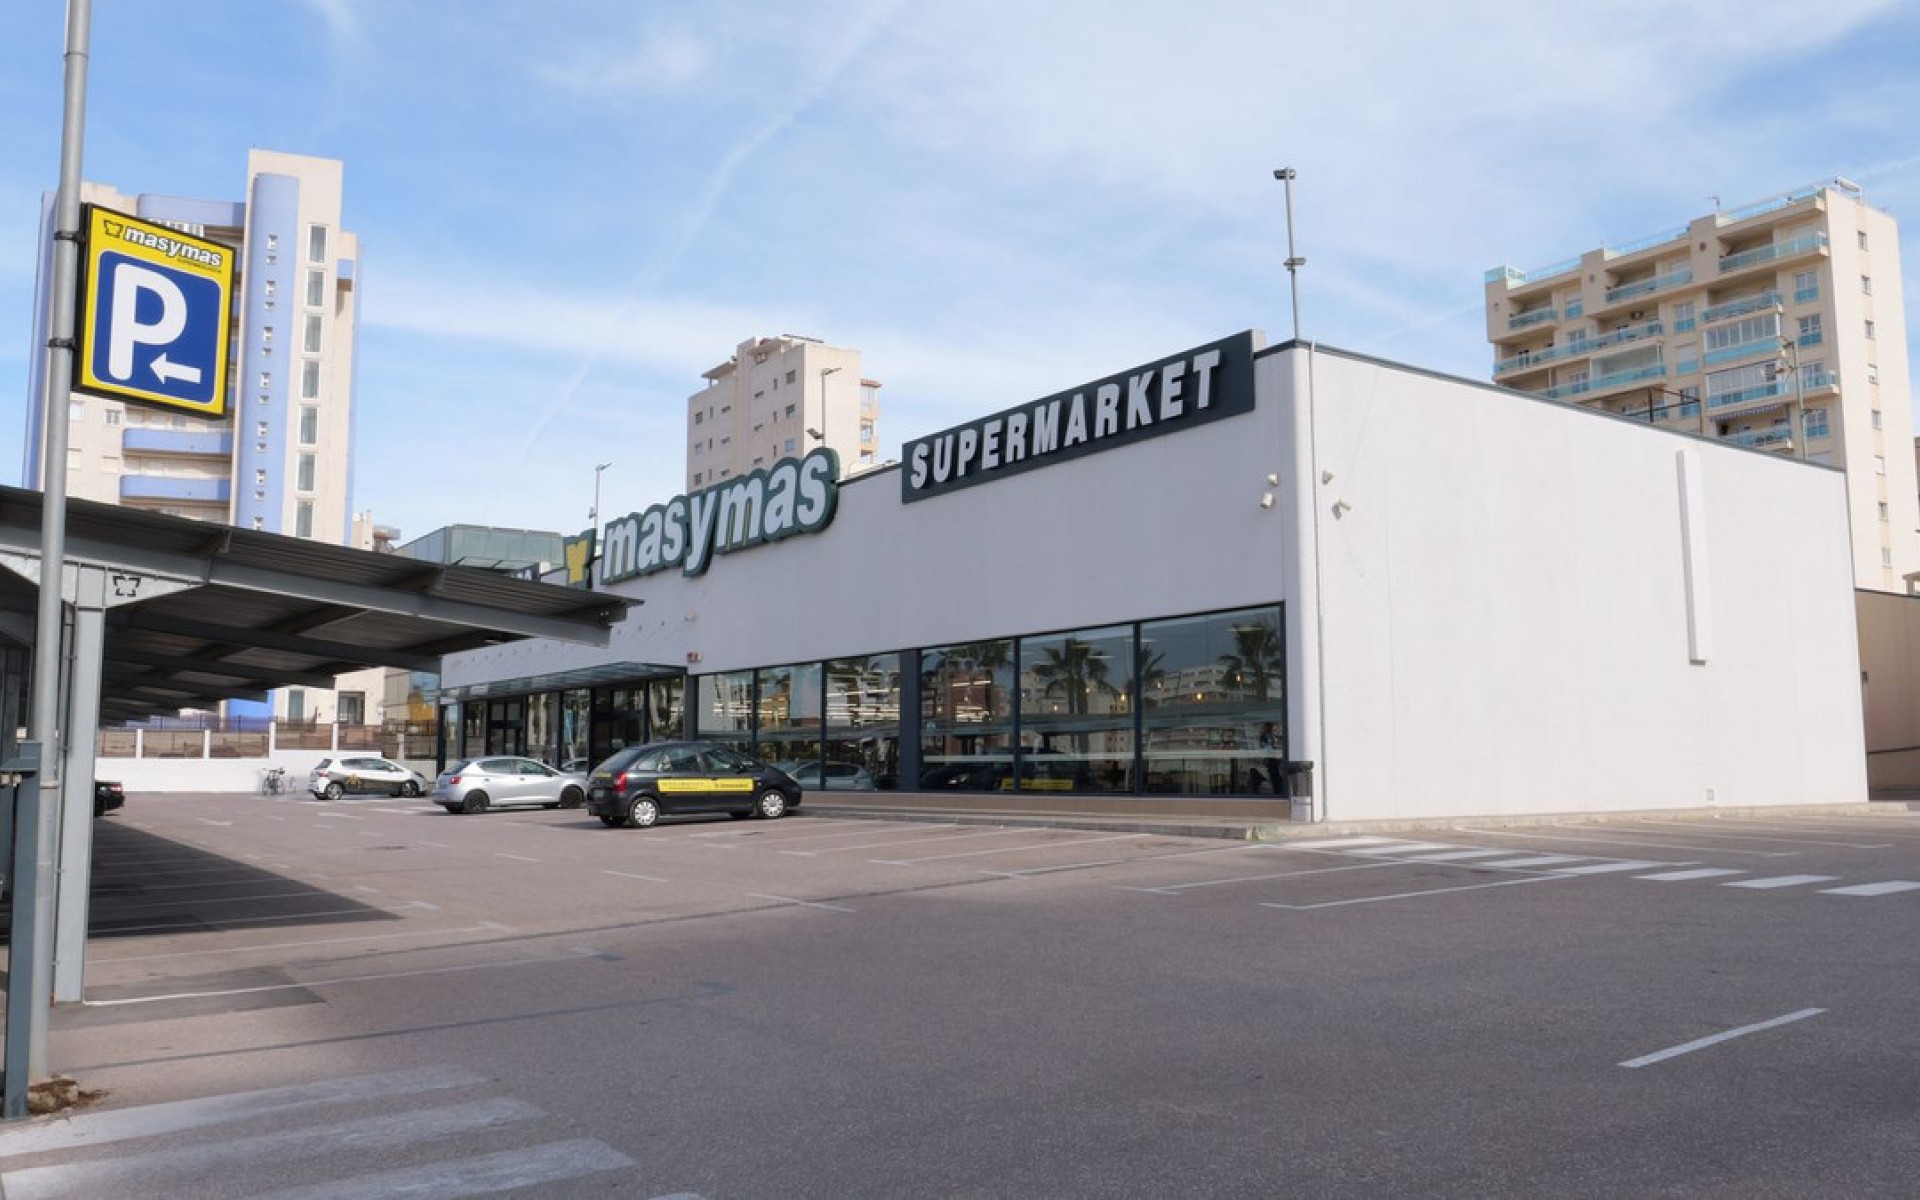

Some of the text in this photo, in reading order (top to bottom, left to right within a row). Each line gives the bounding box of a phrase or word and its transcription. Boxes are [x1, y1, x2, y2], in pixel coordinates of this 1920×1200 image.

[124, 227, 222, 267] masymas
[109, 262, 187, 380] P
[910, 349, 1221, 490] SUPERMARKET
[602, 454, 829, 580] masymas
